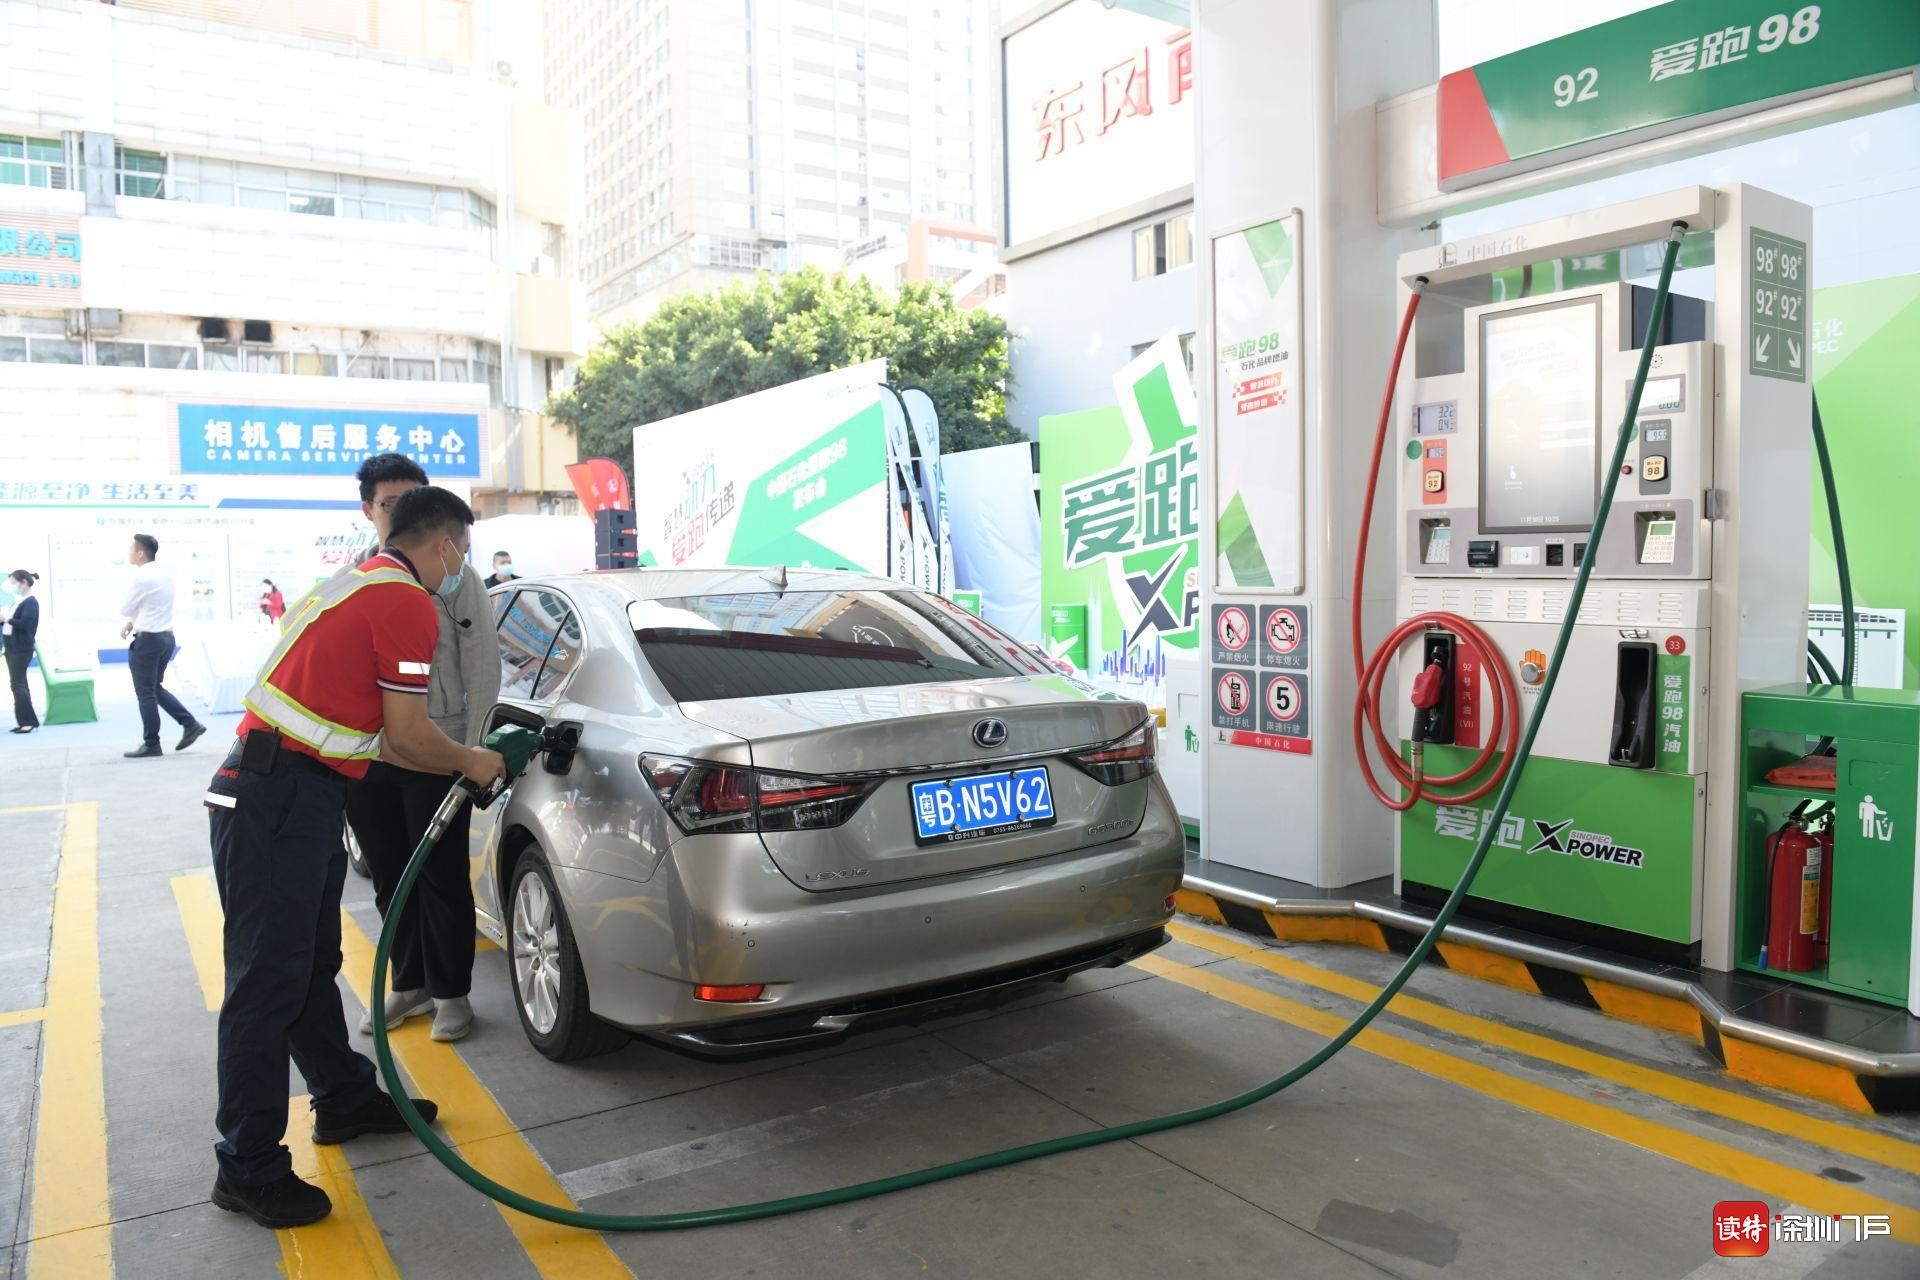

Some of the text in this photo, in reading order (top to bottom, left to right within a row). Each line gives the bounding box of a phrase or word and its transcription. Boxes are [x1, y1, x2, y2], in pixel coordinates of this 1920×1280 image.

[1554, 67, 1599, 107] 92
[204, 418, 465, 453] 相机售后服务中心
[206, 449, 466, 464] CAMERA SERVI ENTER
[1647, 466, 1660, 476] 98
[1428, 480, 1439, 488] 92
[1669, 641, 1680, 650] 33
[1218, 652, 1249, 664] 严禁烟火
[1266, 655, 1300, 666] 停车熄火
[1276, 687, 1290, 711] 5
[1218, 716, 1250, 729] 禁打手机
[1266, 721, 1301, 735] 限速行驶
[1255, 738, 1291, 750] 中国石化
[1434, 805, 1526, 850] 爱跑
[1570, 831, 1611, 844] SINOPEC
